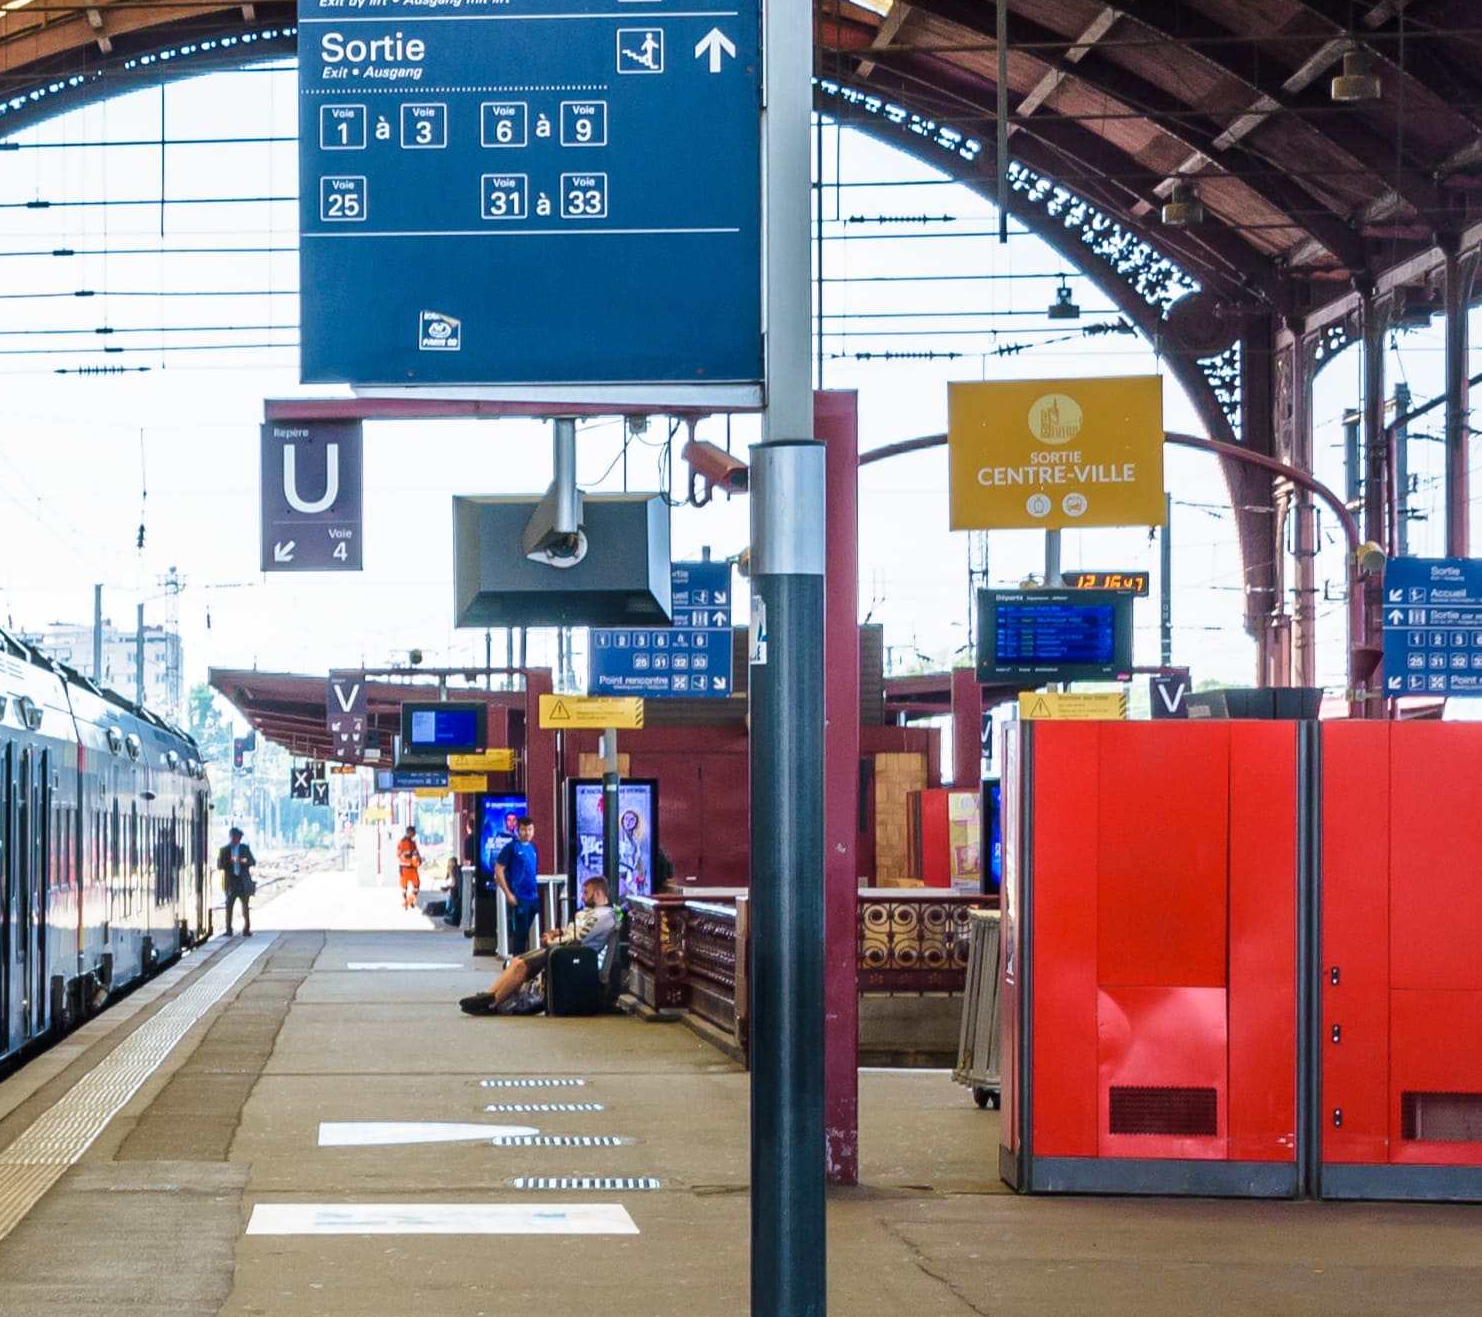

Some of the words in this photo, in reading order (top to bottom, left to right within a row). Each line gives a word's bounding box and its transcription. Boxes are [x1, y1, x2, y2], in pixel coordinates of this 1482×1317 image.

[321, 32, 425, 63] Sortie
[322, 66, 348, 79] Exit
[363, 65, 423, 80] Ausgang
[331, 108, 355, 119] Voie
[412, 107, 435, 118] Voie
[492, 106, 516, 117] Voie
[572, 105, 595, 116] Voie
[337, 122, 348, 144] 1
[375, 116, 390, 140] à
[415, 121, 432, 143] 3
[496, 120, 512, 142] 6
[535, 114, 551, 137] à
[575, 119, 592, 142] 9
[331, 179, 355, 190] Voie
[492, 178, 516, 188] Voie
[572, 177, 595, 187] Voie
[328, 194, 359, 217] 25
[490, 192, 519, 215] 31
[535, 192, 551, 215] à
[568, 190, 601, 214] 33
[273, 428, 309, 439] Repère
[1030, 451, 1082, 464] SORTIE
[283, 443, 339, 514] U
[977, 464, 1135, 486] CENTRE-VILLE
[328, 528, 352, 539] Voie
[333, 541, 348, 562] 4
[1430, 566, 1460, 575] Sortie
[1430, 588, 1466, 597] Accueil
[1430, 610, 1460, 619] Sortie
[599, 637, 605, 645] 1
[618, 637, 626, 645] 2
[637, 637, 645, 645] 3
[1414, 635, 1419, 645] 1
[1434, 635, 1441, 645] 2
[1455, 635, 1463, 645] 3
[635, 658, 647, 667] 25
[655, 658, 666, 667] 31
[674, 658, 686, 667] 32
[694, 658, 706, 667] 33
[1410, 657, 1423, 666] 25
[1431, 657, 1444, 666] 31
[1452, 657, 1466, 666] 32
[599, 676, 623, 684] Point
[625, 676, 668, 684] rencontre
[1451, 675, 1476, 684] Point
[334, 683, 360, 712] V
[1158, 684, 1185, 713] V
[295, 771, 308, 788] X
[316, 785, 326, 798] Y
